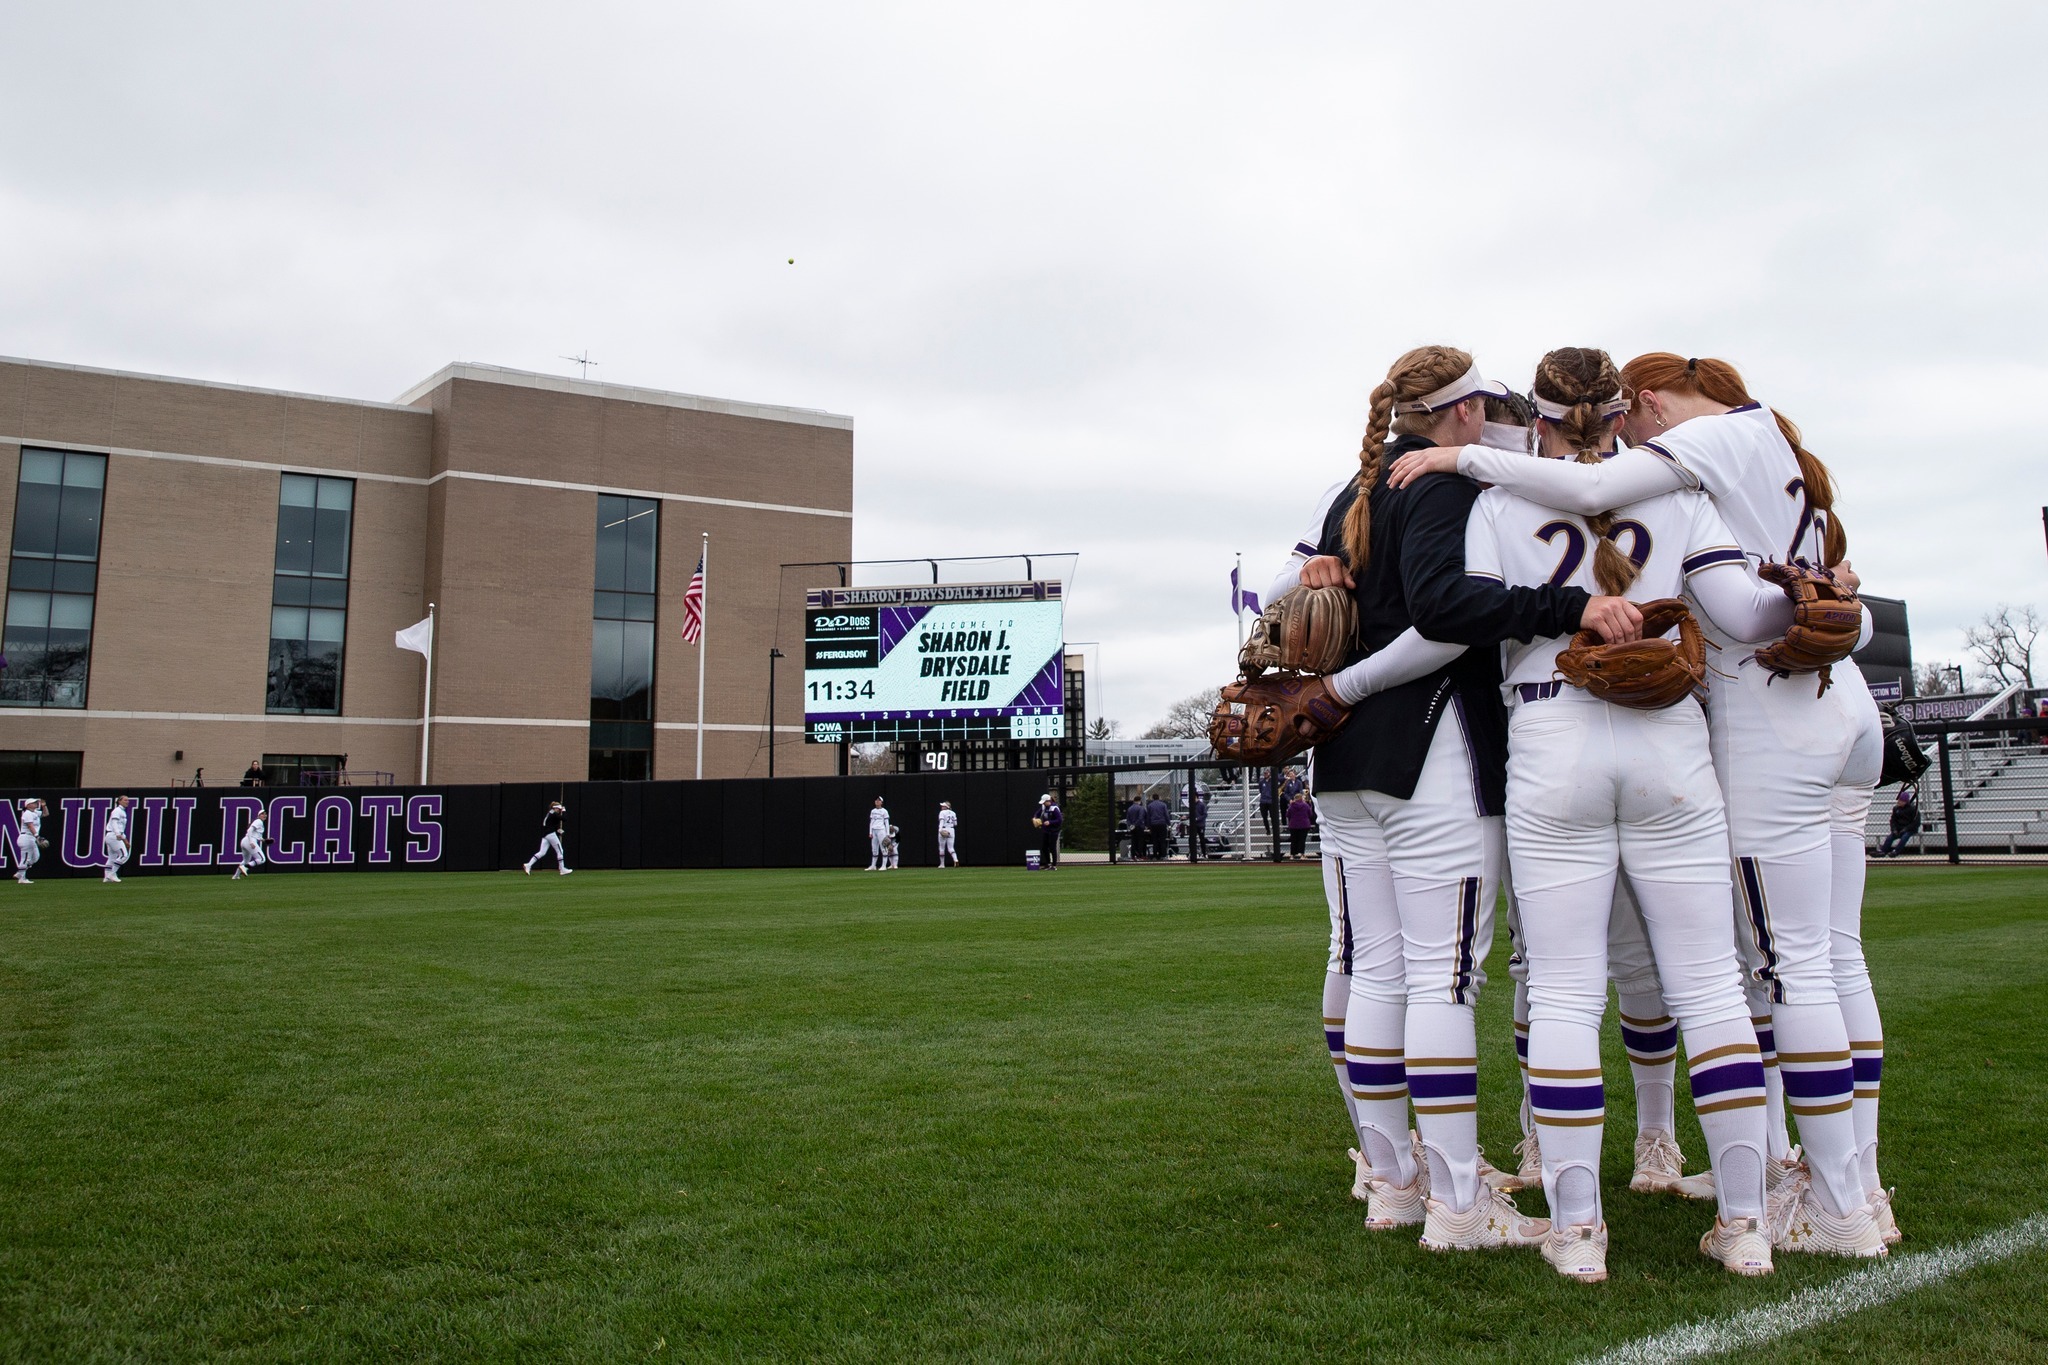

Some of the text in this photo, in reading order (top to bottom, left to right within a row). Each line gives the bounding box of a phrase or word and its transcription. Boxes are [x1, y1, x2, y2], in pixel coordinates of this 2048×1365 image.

[843, 585, 1022, 605] SHARON J. DRYSDALE FIELD
[814, 615, 870, 628] D&D DOGS
[922, 620, 1014, 629] WELCOME TO
[918, 630, 1010, 653] SHARON J.
[823, 649, 868, 659] FERGUSON
[920, 655, 1011, 677] DRYSDALE
[808, 680, 875, 701] 11:34
[941, 680, 990, 701] FIELD
[1869, 686, 1900, 697] ECTION 102
[814, 723, 842, 732] IOWA
[814, 734, 842, 743] 'CATS
[926, 752, 948, 770] 90
[60, 794, 443, 869] WILDCATS
